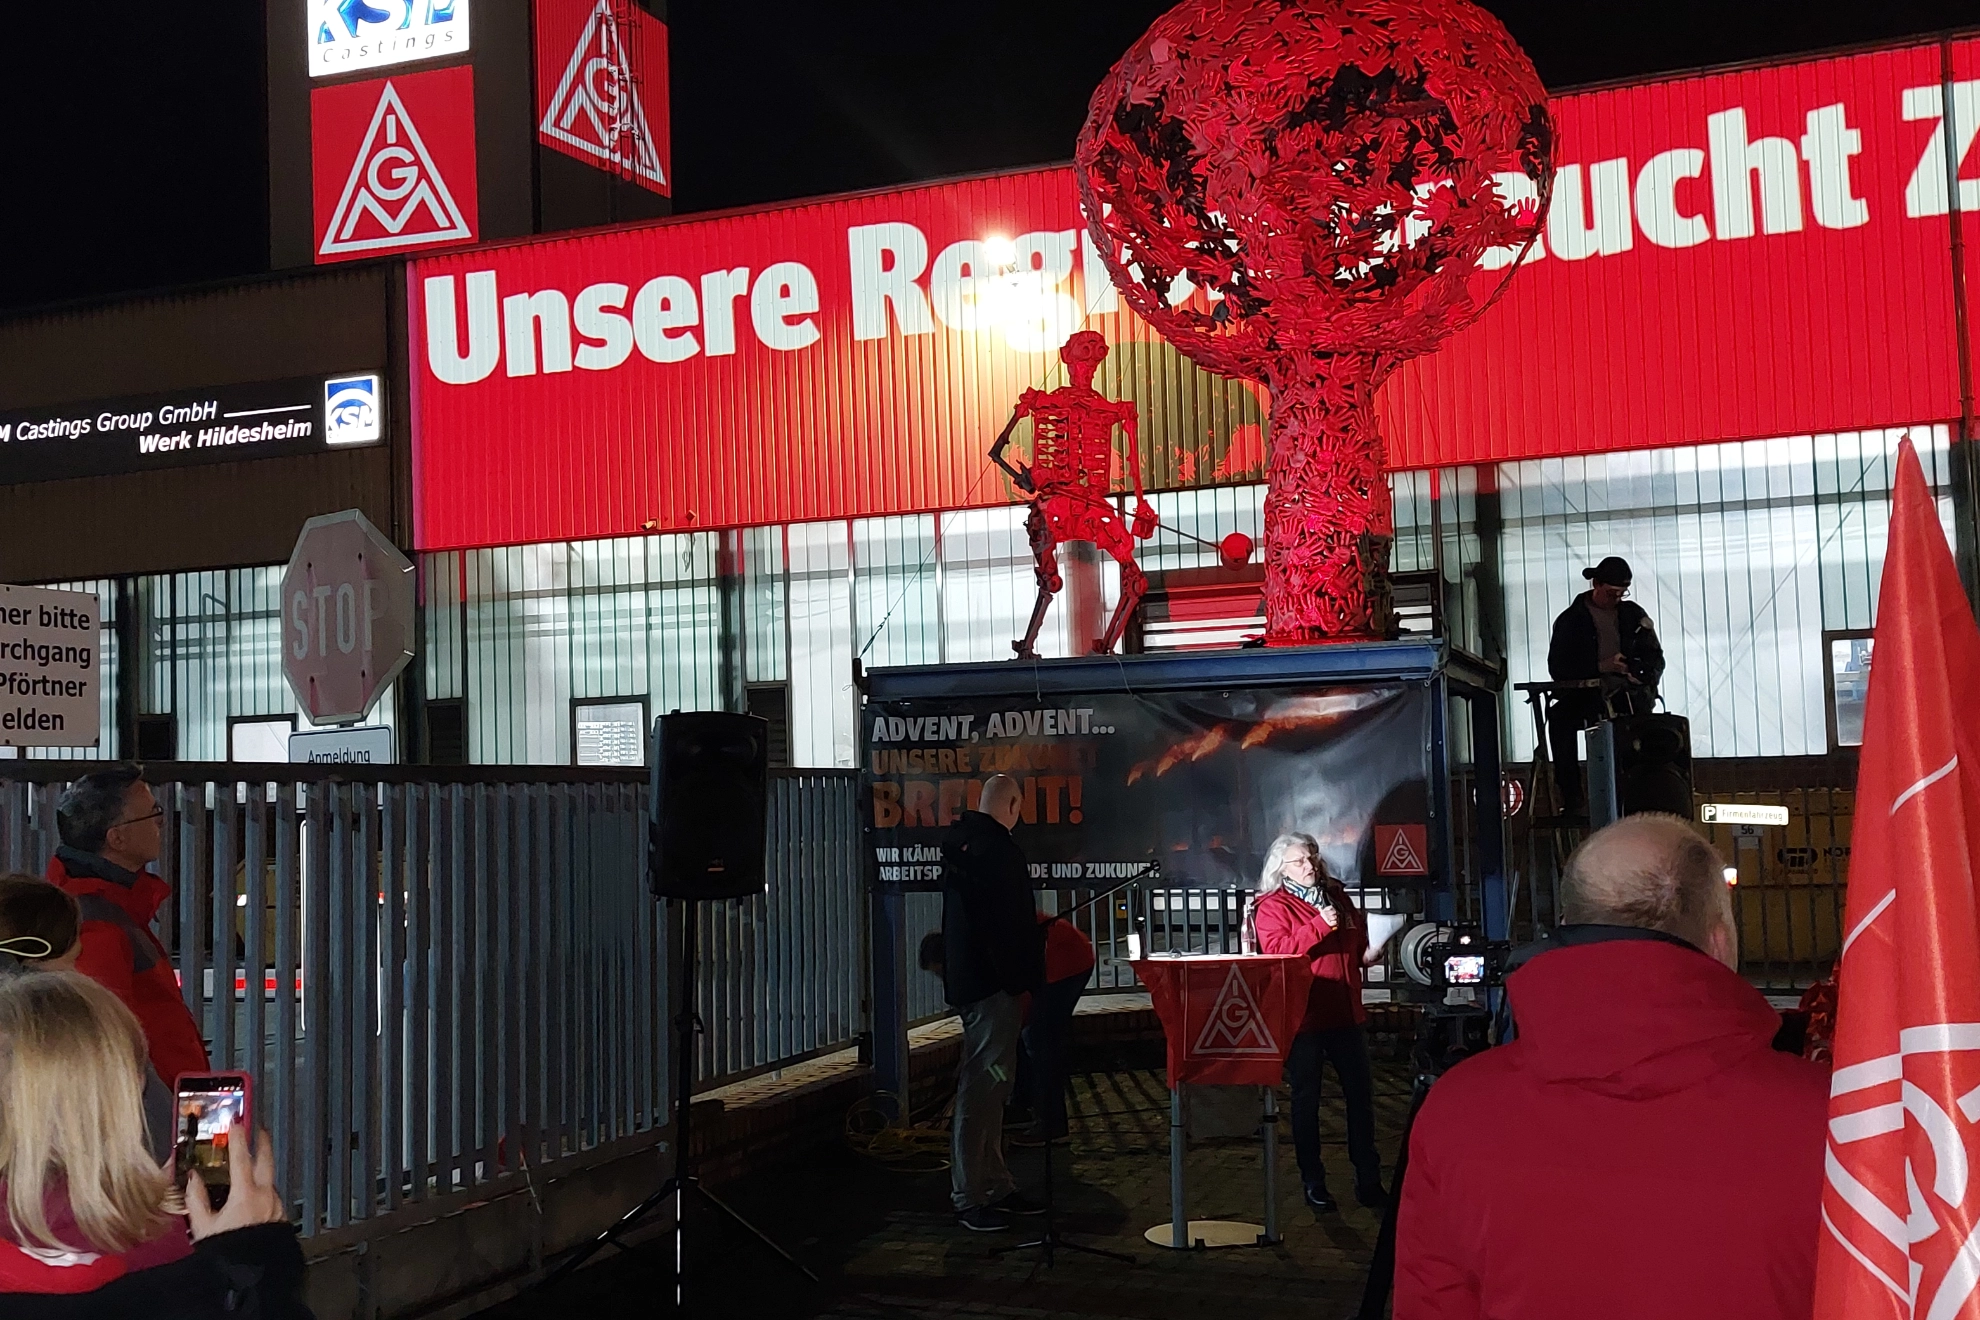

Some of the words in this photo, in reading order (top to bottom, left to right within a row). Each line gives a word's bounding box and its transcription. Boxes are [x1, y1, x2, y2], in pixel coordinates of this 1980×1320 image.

[323, 31, 453, 62] Castings
[424, 261, 820, 385] Unsere
[16, 417, 91, 441] Castings
[97, 409, 152, 431] Group
[159, 400, 217, 424] GmbH
[139, 431, 191, 453] Werk
[197, 419, 312, 448] Hildesheim
[39, 605, 90, 630] bitte
[292, 579, 389, 660] STOP
[1, 638, 90, 669] rchgang
[2, 707, 64, 730] elden
[872, 714, 980, 743] ADVENT,
[986, 708, 1115, 739] ADVENT...
[308, 747, 371, 764] Anmeldung
[871, 746, 972, 775] UNSERE
[876, 847, 900, 862] WIR
[1027, 863, 1048, 878] DE
[1052, 863, 1082, 878] UND
